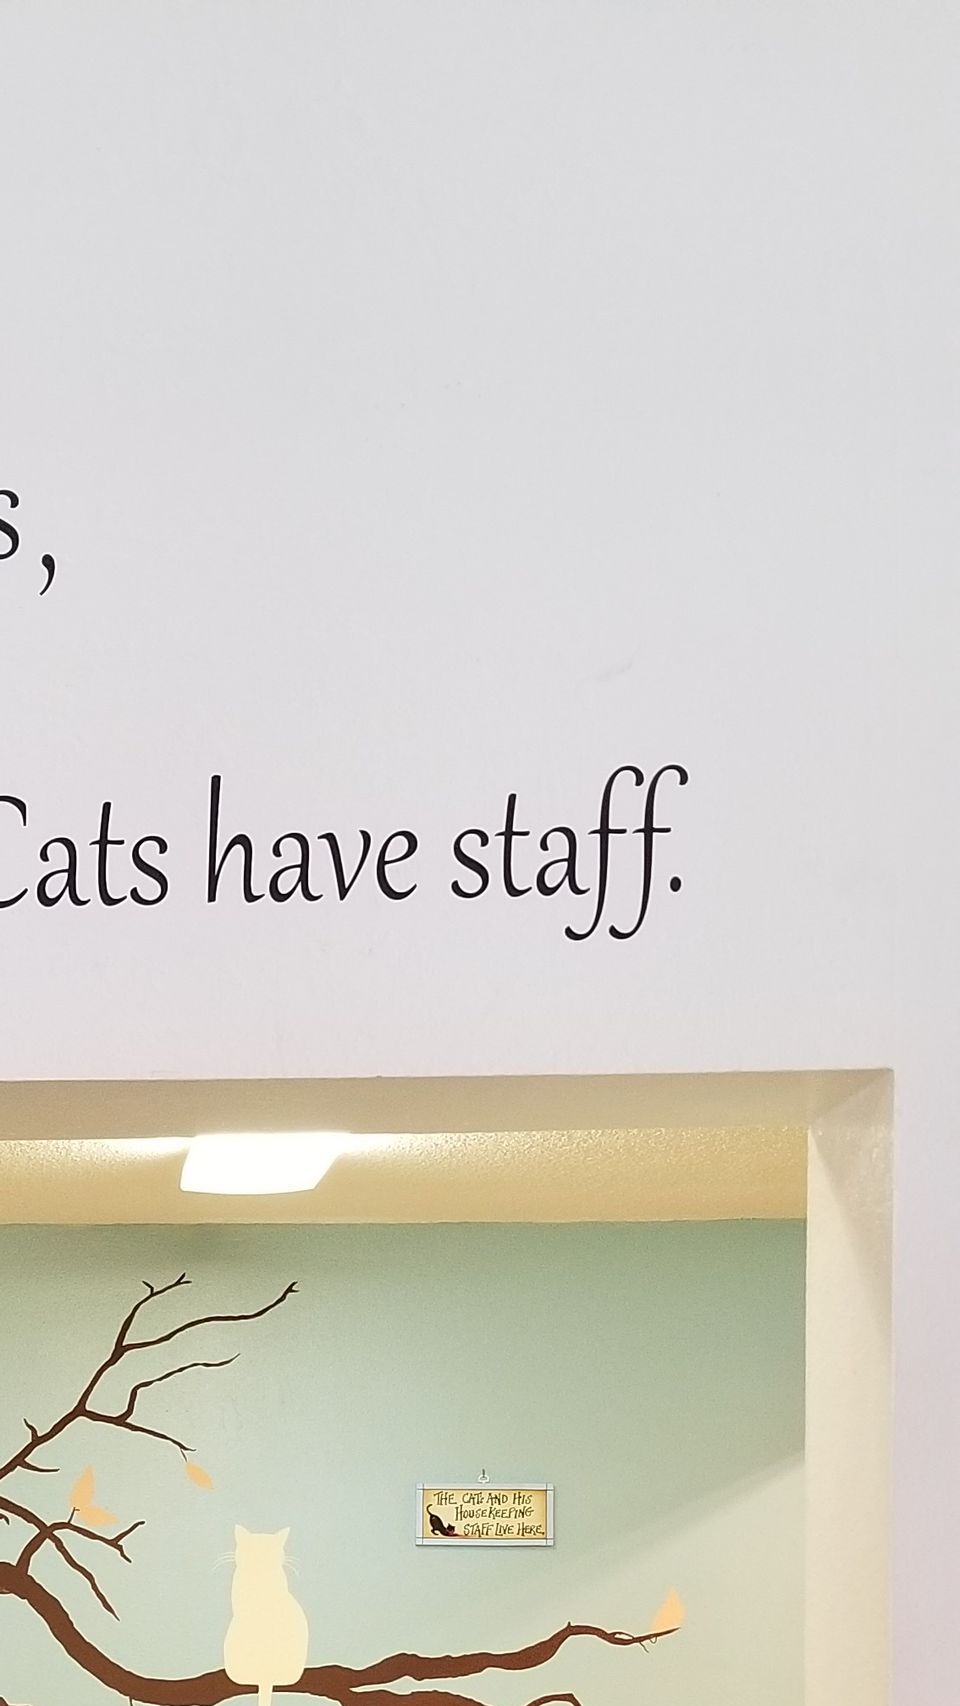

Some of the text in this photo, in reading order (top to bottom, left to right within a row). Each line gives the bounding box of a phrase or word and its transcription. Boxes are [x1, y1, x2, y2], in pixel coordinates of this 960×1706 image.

[208, 775, 417, 903] have
[452, 765, 688, 940] staff.
[434, 1491, 457, 1505] THE
[486, 1492, 508, 1506] AND
[512, 1492, 533, 1506] HIS
[455, 1504, 534, 1521] HOUSEKEEPING
[463, 1522, 545, 1537] STAFF LIVE HERE.
